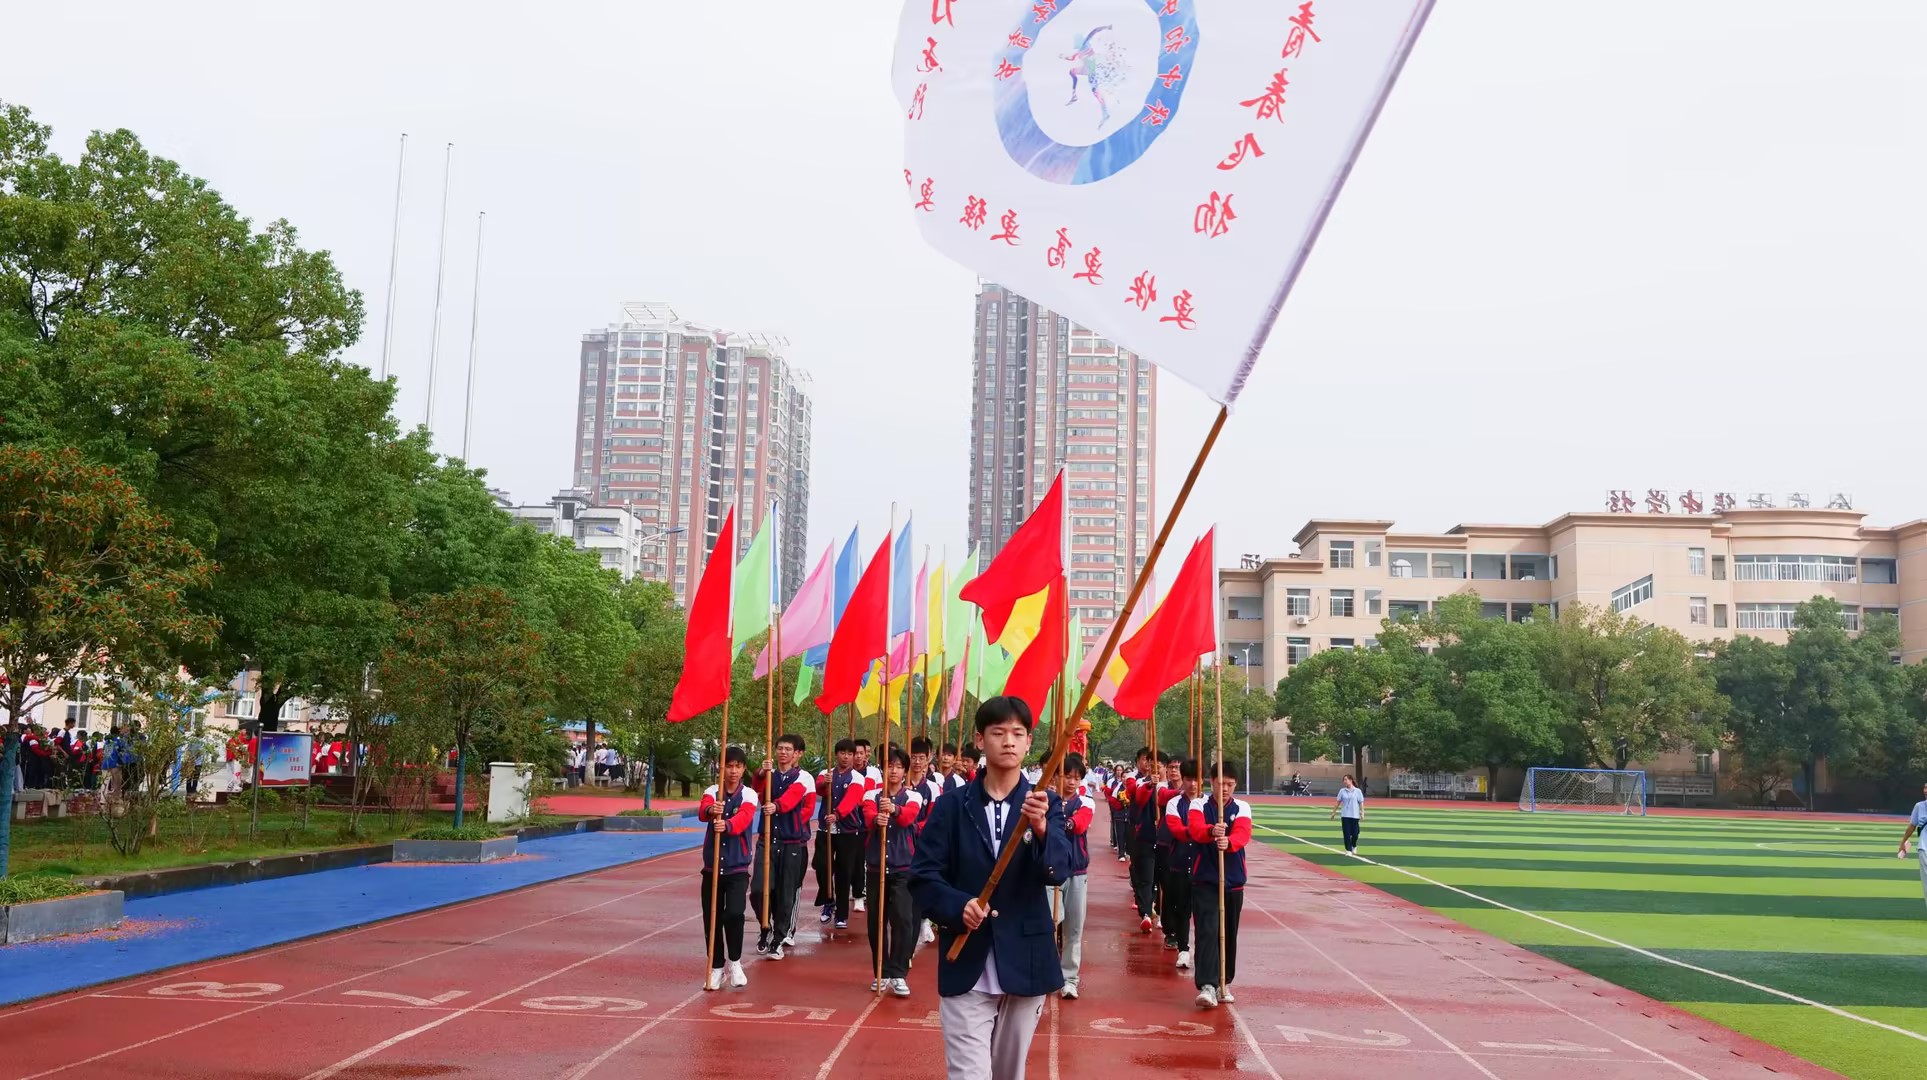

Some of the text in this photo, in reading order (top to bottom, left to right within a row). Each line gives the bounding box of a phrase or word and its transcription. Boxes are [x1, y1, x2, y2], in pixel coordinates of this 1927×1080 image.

[148, 981, 285, 998] 8
[341, 989, 471, 1007] 7
[709, 1002, 837, 1022] 5
[1088, 1017, 1216, 1037] 3
[1275, 1024, 1412, 1047] 2
[1480, 1040, 1612, 1053] 1
